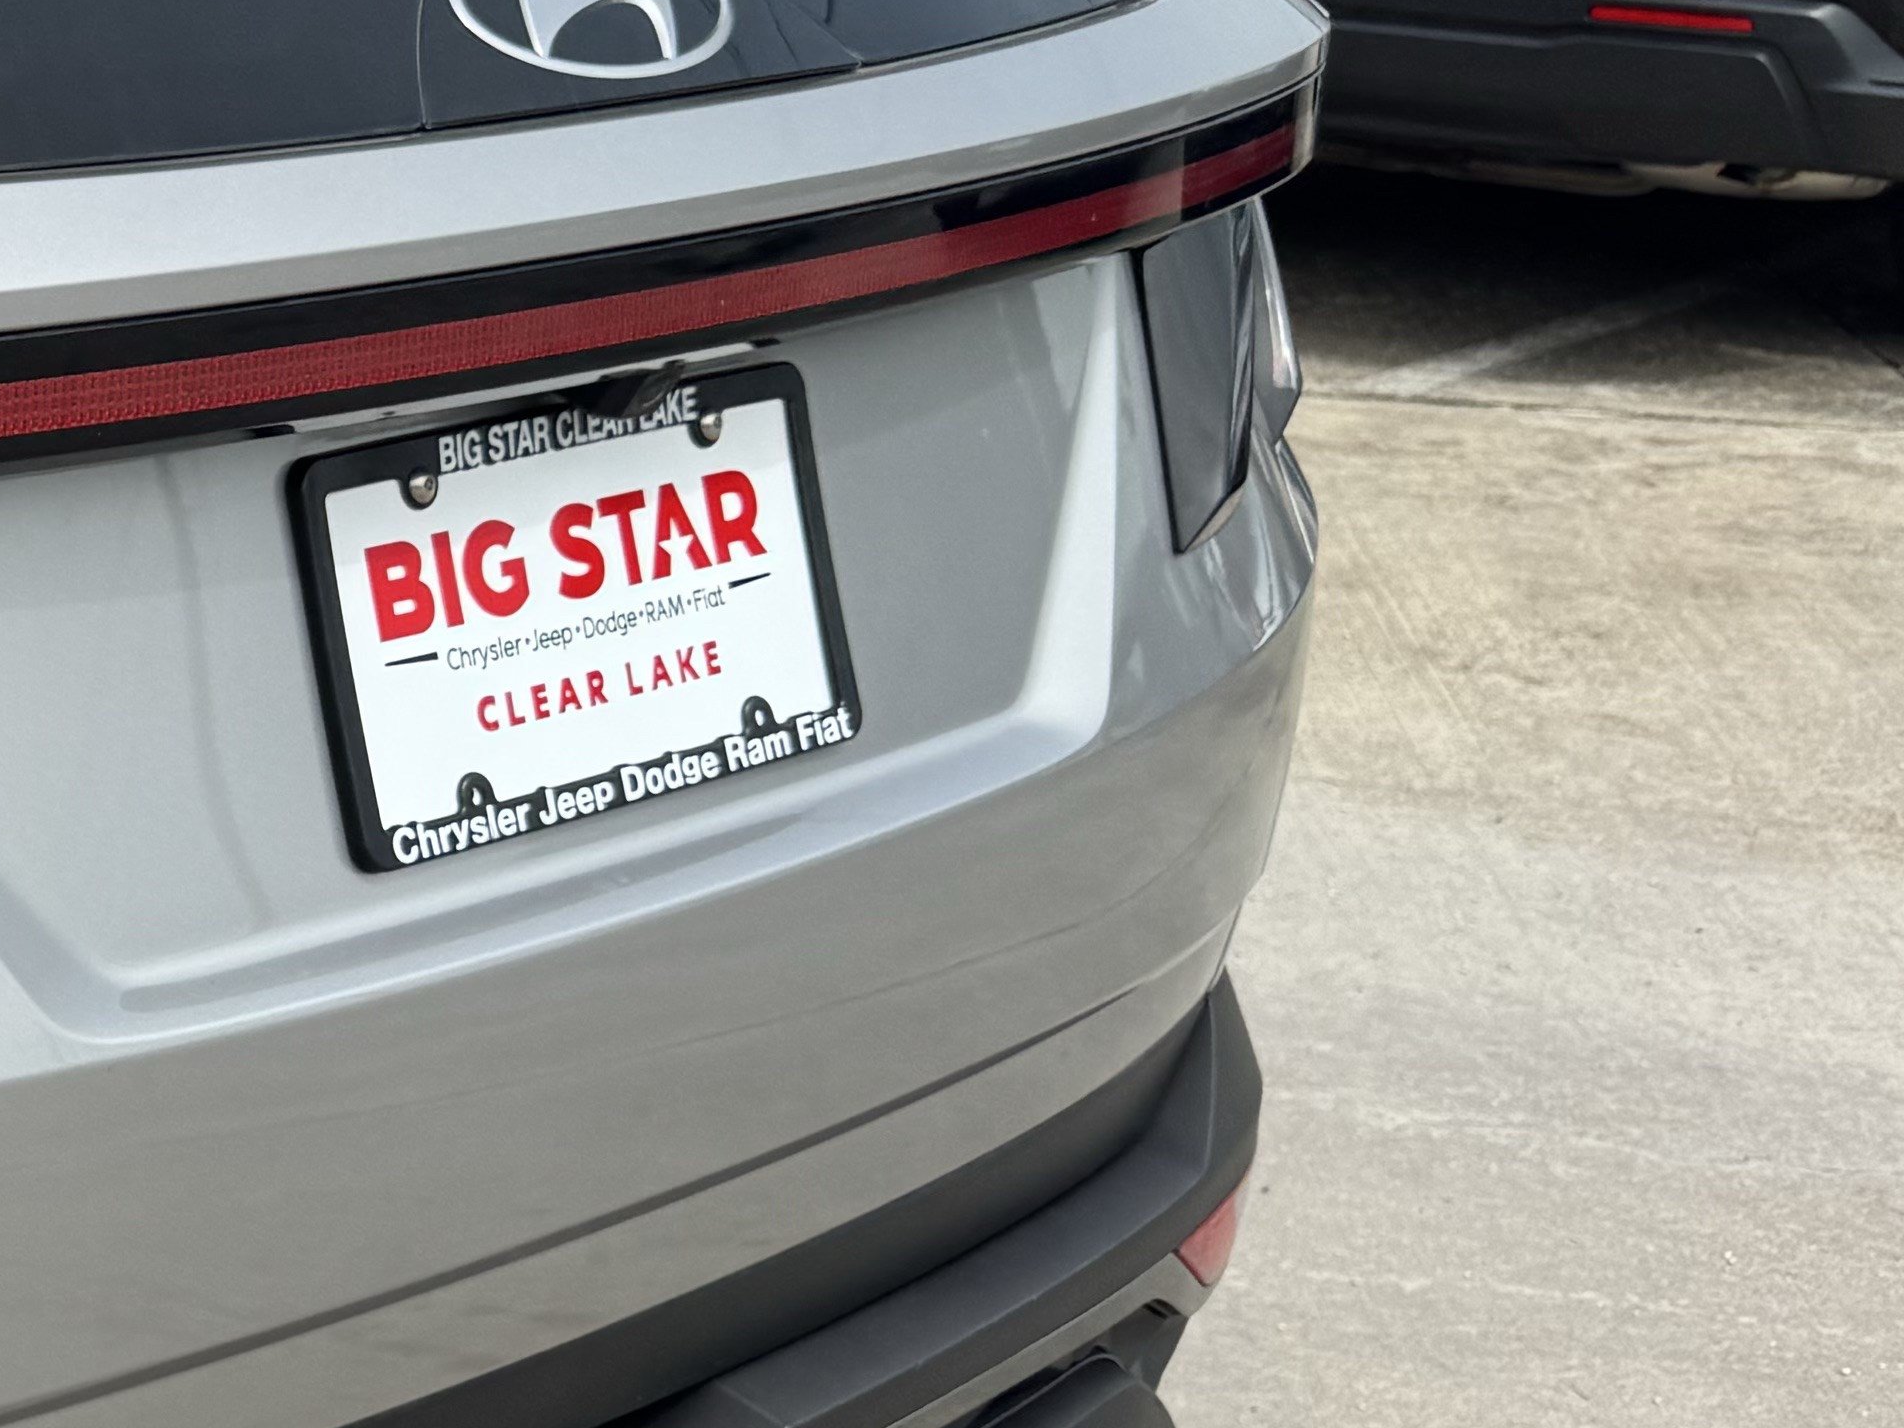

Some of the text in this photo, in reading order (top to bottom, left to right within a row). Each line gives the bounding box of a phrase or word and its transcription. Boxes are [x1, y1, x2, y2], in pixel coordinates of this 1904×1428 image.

[438, 432, 483, 472] BIG
[488, 415, 553, 462] STAR
[363, 469, 768, 644] BIG STAR
[476, 639, 723, 733] CLEAR LAKE
[391, 705, 854, 866] Chrysler Jeep Dodge Ram Fiat
